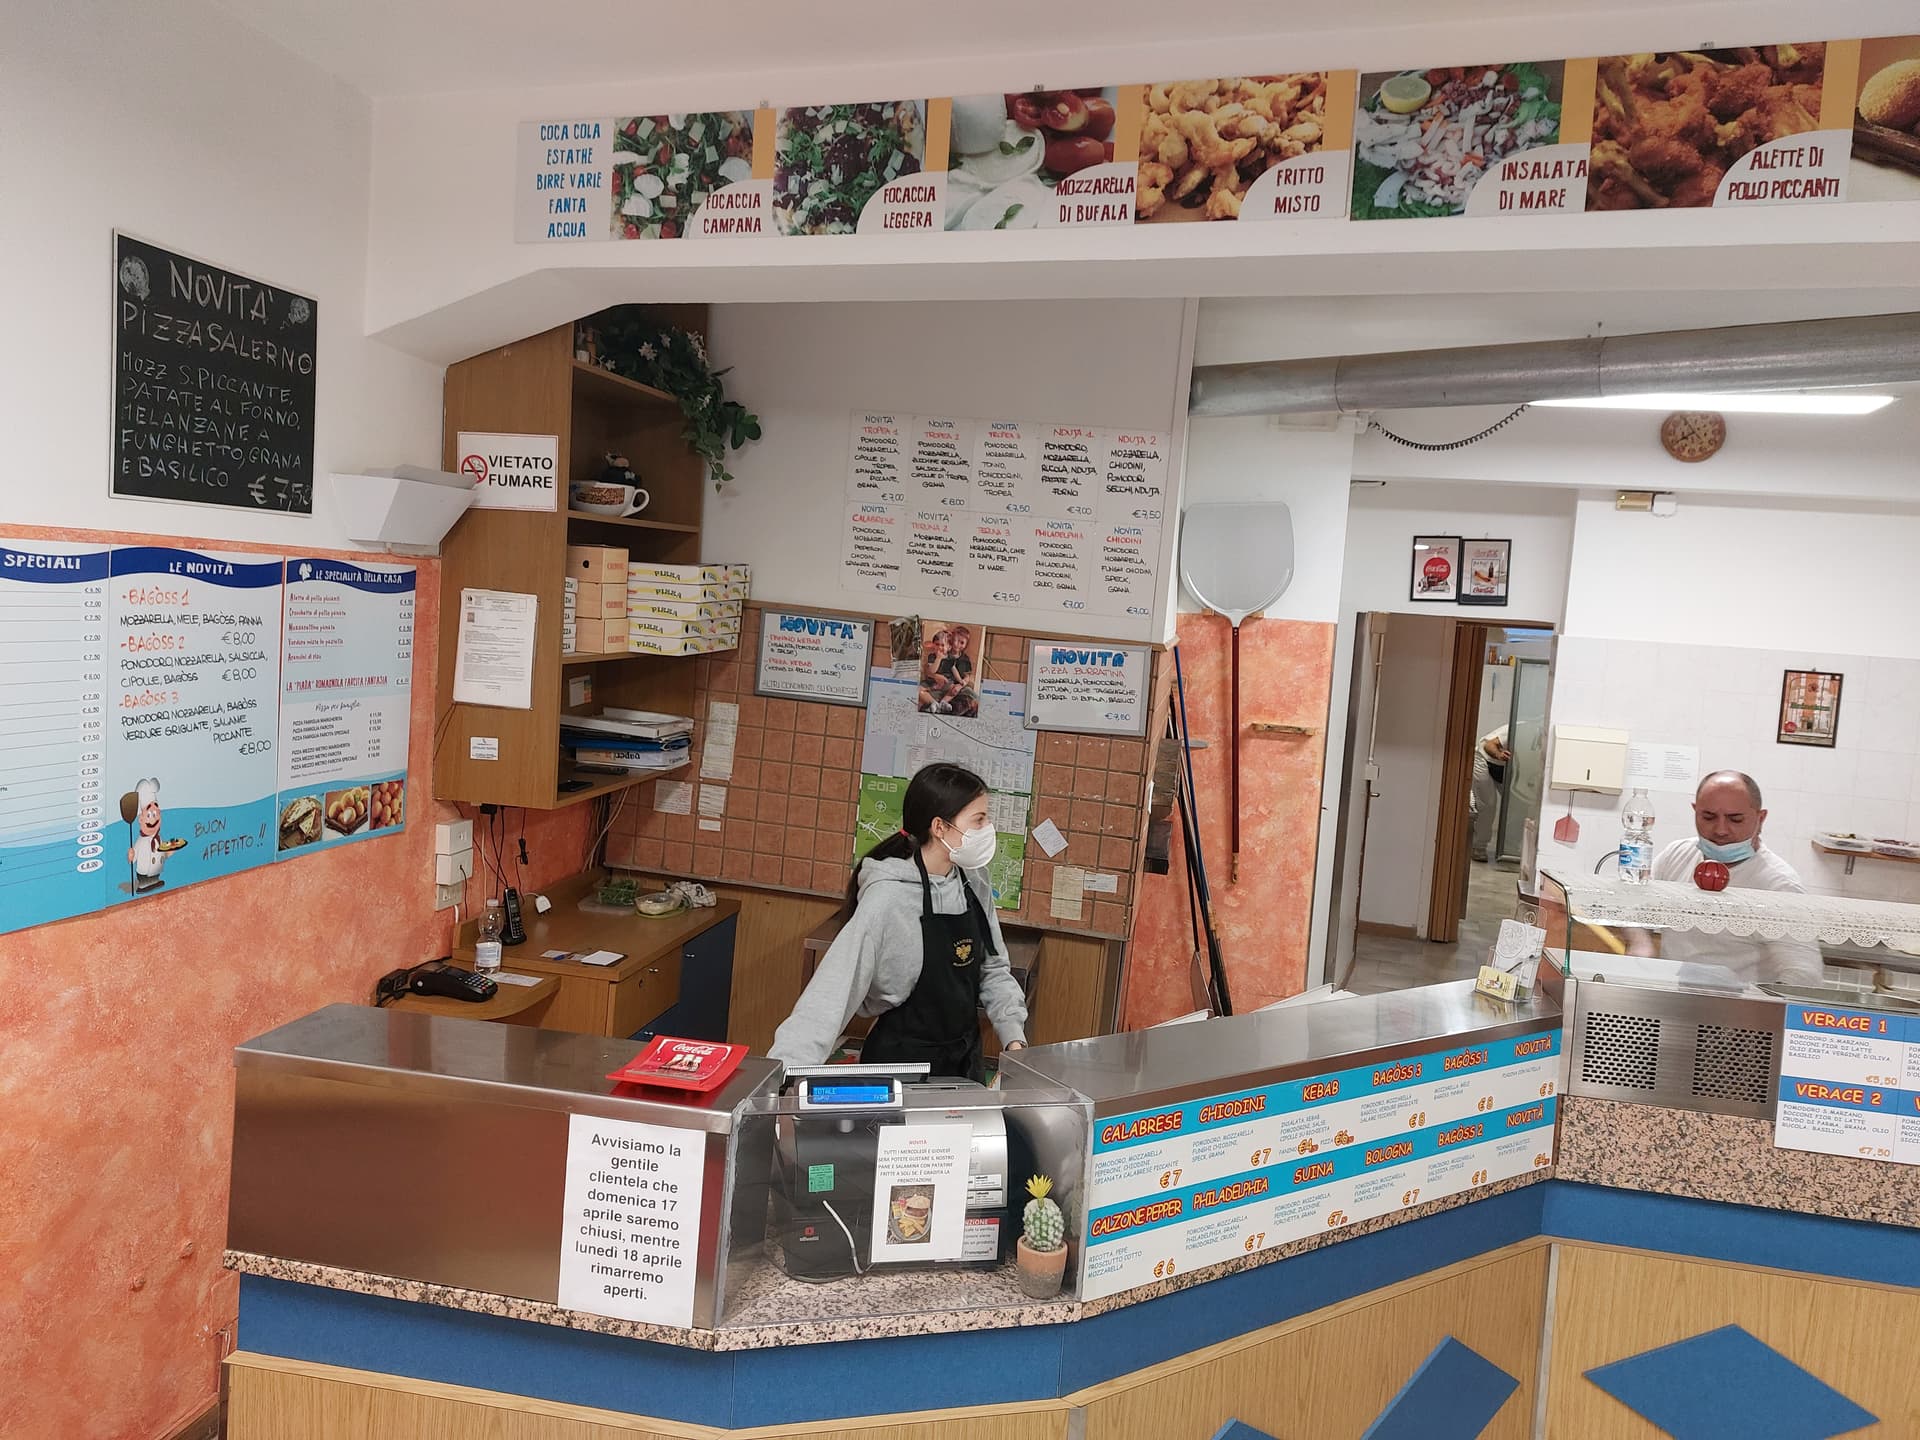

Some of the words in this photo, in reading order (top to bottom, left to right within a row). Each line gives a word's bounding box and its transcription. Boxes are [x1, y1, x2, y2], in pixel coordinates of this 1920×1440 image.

[541, 124, 568, 140] COCA
[574, 123, 600, 139] COLA
[547, 148, 593, 165] ESTATHE
[1750, 148, 1804, 170] ALETTE
[1809, 146, 1822, 167] DI
[1277, 166, 1324, 187] FRITTO
[1502, 159, 1587, 181] INSALATA
[537, 174, 565, 190] BIRRE
[569, 172, 602, 188] VARIE
[1056, 175, 1135, 196] MOZZARELLA
[1728, 179, 1768, 200] POLLO
[1771, 178, 1839, 198] PICCANTI
[706, 193, 761, 211] FOCACCIA
[883, 185, 936, 204] FOCACCIA
[1274, 194, 1320, 214] MISTO
[1500, 191, 1513, 210] DI
[1520, 188, 1565, 209] MARE
[549, 198, 586, 213] FANTA
[1060, 205, 1071, 223] DI
[1076, 204, 1128, 221] BUFALA
[547, 222, 586, 238] ACQUA
[704, 216, 762, 234] CAMPANA
[884, 211, 932, 229] LEGGERA
[123, 377, 203, 411] PATATE
[210, 399, 231, 416] AL
[241, 402, 300, 430] FORNO,
[258, 431, 269, 440] A
[1151, 436, 1156, 445] 2
[249, 447, 300, 469] GRANA
[489, 456, 552, 469] VIETATO
[123, 460, 131, 473] E
[139, 456, 228, 487] BASILICO
[489, 474, 552, 488] FUMARE
[4, 554, 80, 569] SPECIALI
[169, 563, 181, 573] LE
[187, 562, 233, 575] NOVITÀ
[316, 570, 323, 579] LE
[325, 570, 361, 582] SPECIALITÀ
[364, 572, 381, 582] DELLA
[384, 574, 402, 584] CASA
[182, 589, 189, 606] 1
[239, 616, 263, 626] PANNA
[179, 636, 184, 649] 2
[1040, 666, 1068, 674] PIZZA
[172, 692, 179, 704] 3
[123, 727, 162, 741] VERDURE
[214, 715, 247, 728] SALAME
[213, 727, 252, 743] PICCANTE
[867, 781, 897, 792] 2013
[195, 818, 226, 837] BUON
[203, 836, 253, 860] APPETITO
[1803, 1011, 1871, 1031] VERACE
[1879, 1019, 1887, 1033] 1
[1515, 1034, 1552, 1057] NOVITÀ
[1444, 1048, 1481, 1072] BAGÒSS
[1484, 1048, 1488, 1063] 1
[1373, 1063, 1414, 1086] BAGÒSS
[1416, 1063, 1422, 1077] 3
[1302, 1080, 1339, 1102] KEBAB
[1796, 1083, 1864, 1104] VERACE
[1871, 1091, 1882, 1106] 2
[1199, 1095, 1266, 1123] CHIODINI
[1506, 1103, 1544, 1128] NOVITÀ
[1102, 1111, 1182, 1144] CALABRESE
[1438, 1123, 1475, 1147] BAGÒSS
[1478, 1123, 1483, 1136] 2
[591, 1133, 664, 1154] Avvisiamo
[670, 1144, 681, 1157] la
[1365, 1140, 1413, 1166] BOLOGNA
[611, 1157, 659, 1172] gentile
[1294, 1160, 1334, 1184] SUINA
[589, 1171, 648, 1189] clientela
[653, 1180, 678, 1193] che
[588, 1189, 655, 1209] domenica
[662, 1199, 677, 1211] 17
[1193, 1177, 1268, 1210] PHILADELPHIA
[583, 1208, 622, 1222] aprile
[627, 1215, 679, 1231] saremo
[580, 1225, 626, 1243] chiusi,
[631, 1233, 680, 1249] mentre
[576, 1241, 618, 1259] lunedì
[623, 1249, 638, 1261] 18
[642, 1254, 682, 1268] aprile
[591, 1263, 663, 1284] rimarremo
[603, 1284, 647, 1300] aperti.
